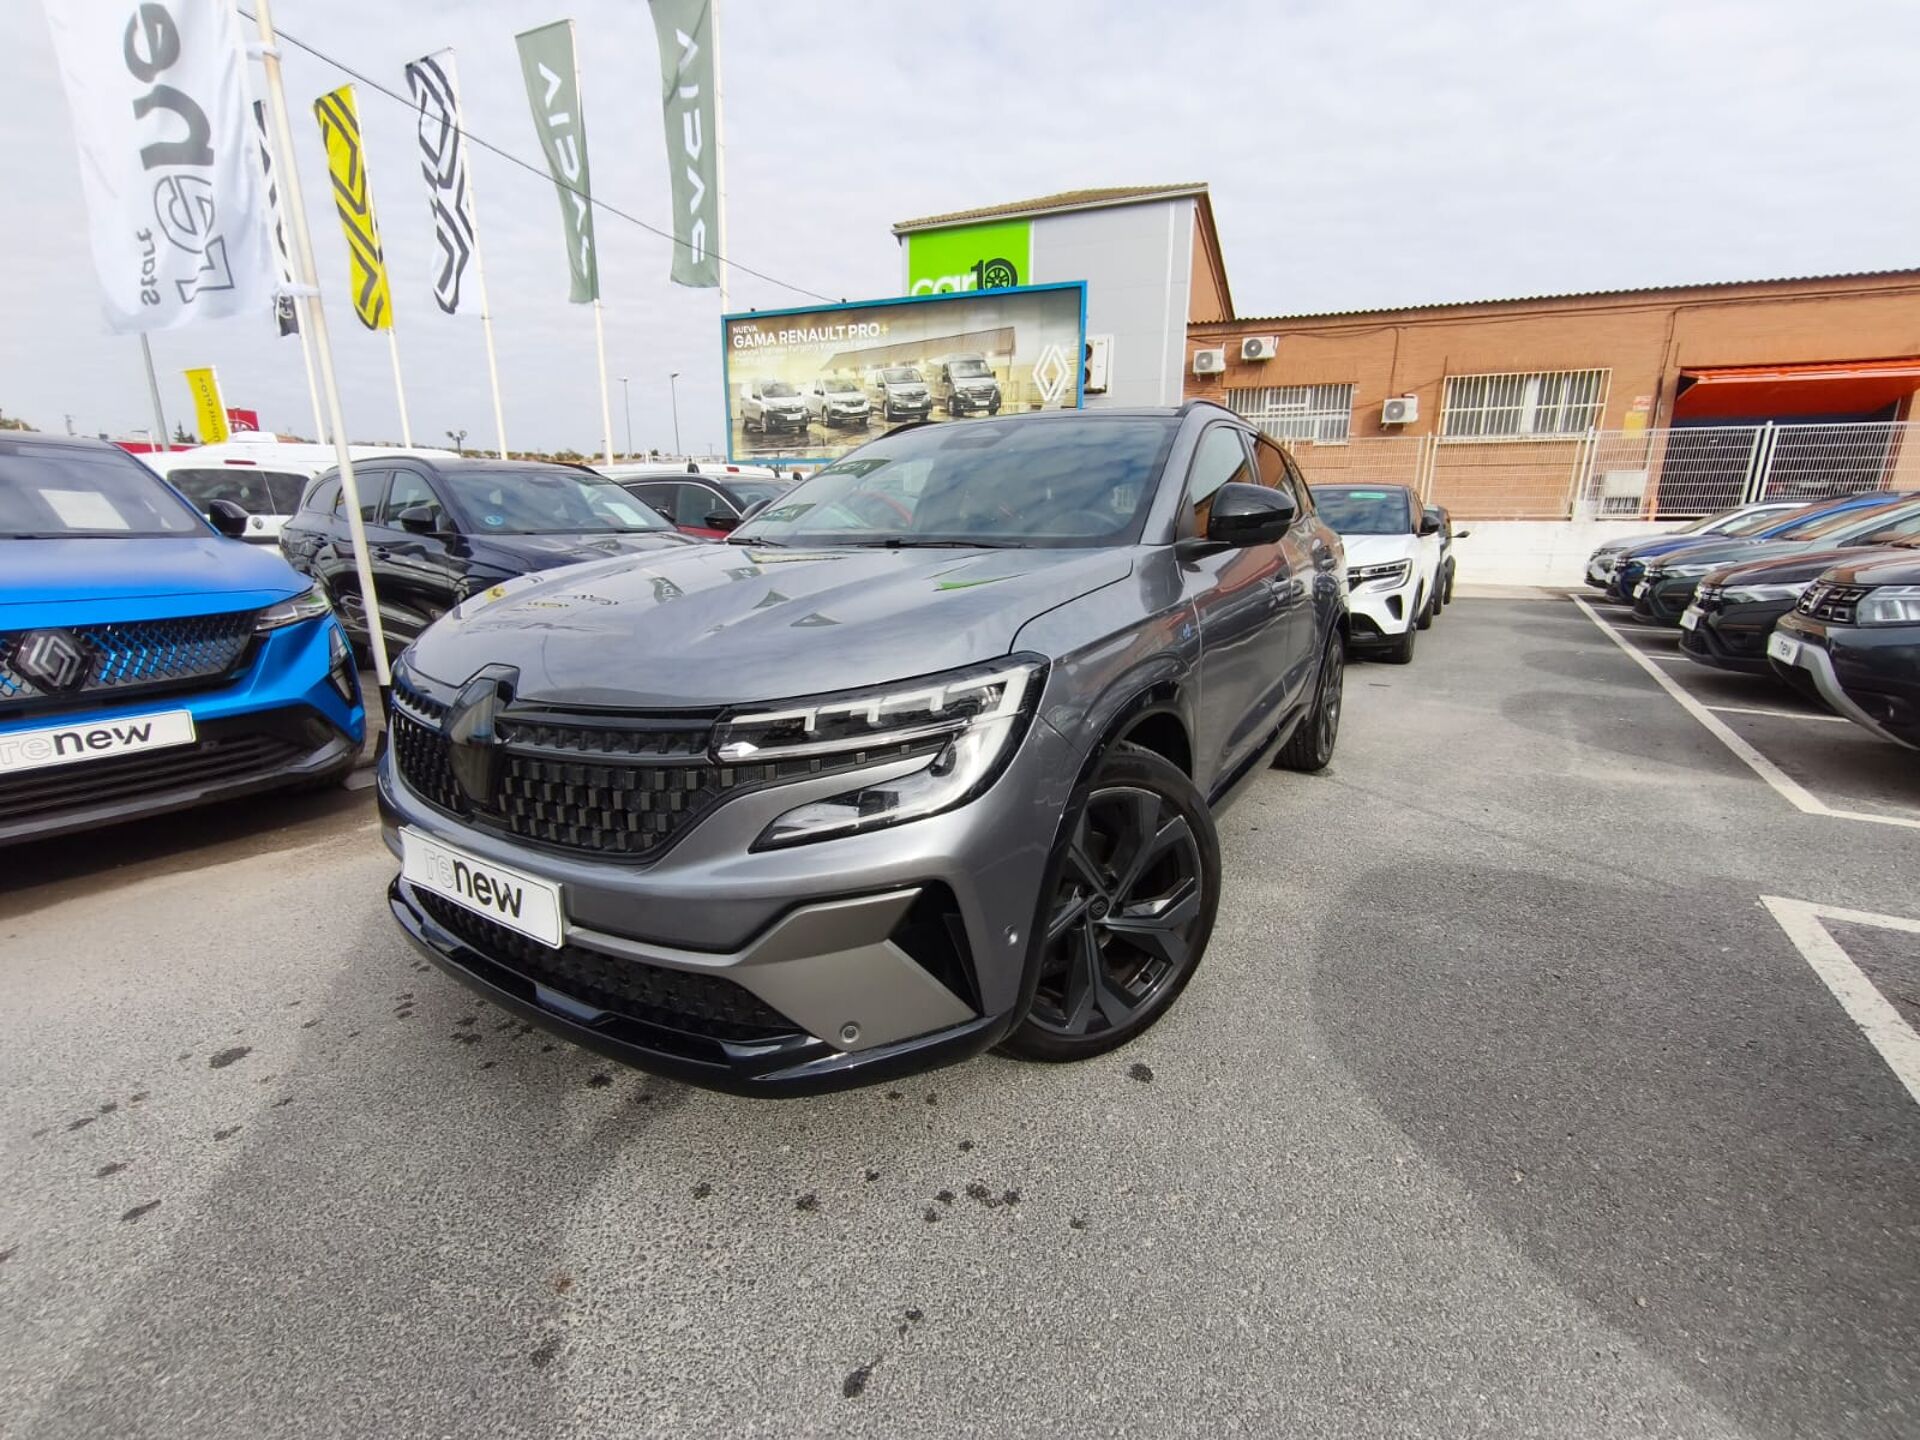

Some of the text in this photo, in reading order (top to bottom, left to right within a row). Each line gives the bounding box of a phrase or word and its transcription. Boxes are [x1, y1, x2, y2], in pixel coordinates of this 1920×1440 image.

[732, 325, 758, 334] NUEVA
[733, 322, 889, 349] GAMA RENAULT PRO+
[424, 848, 523, 919] renew
